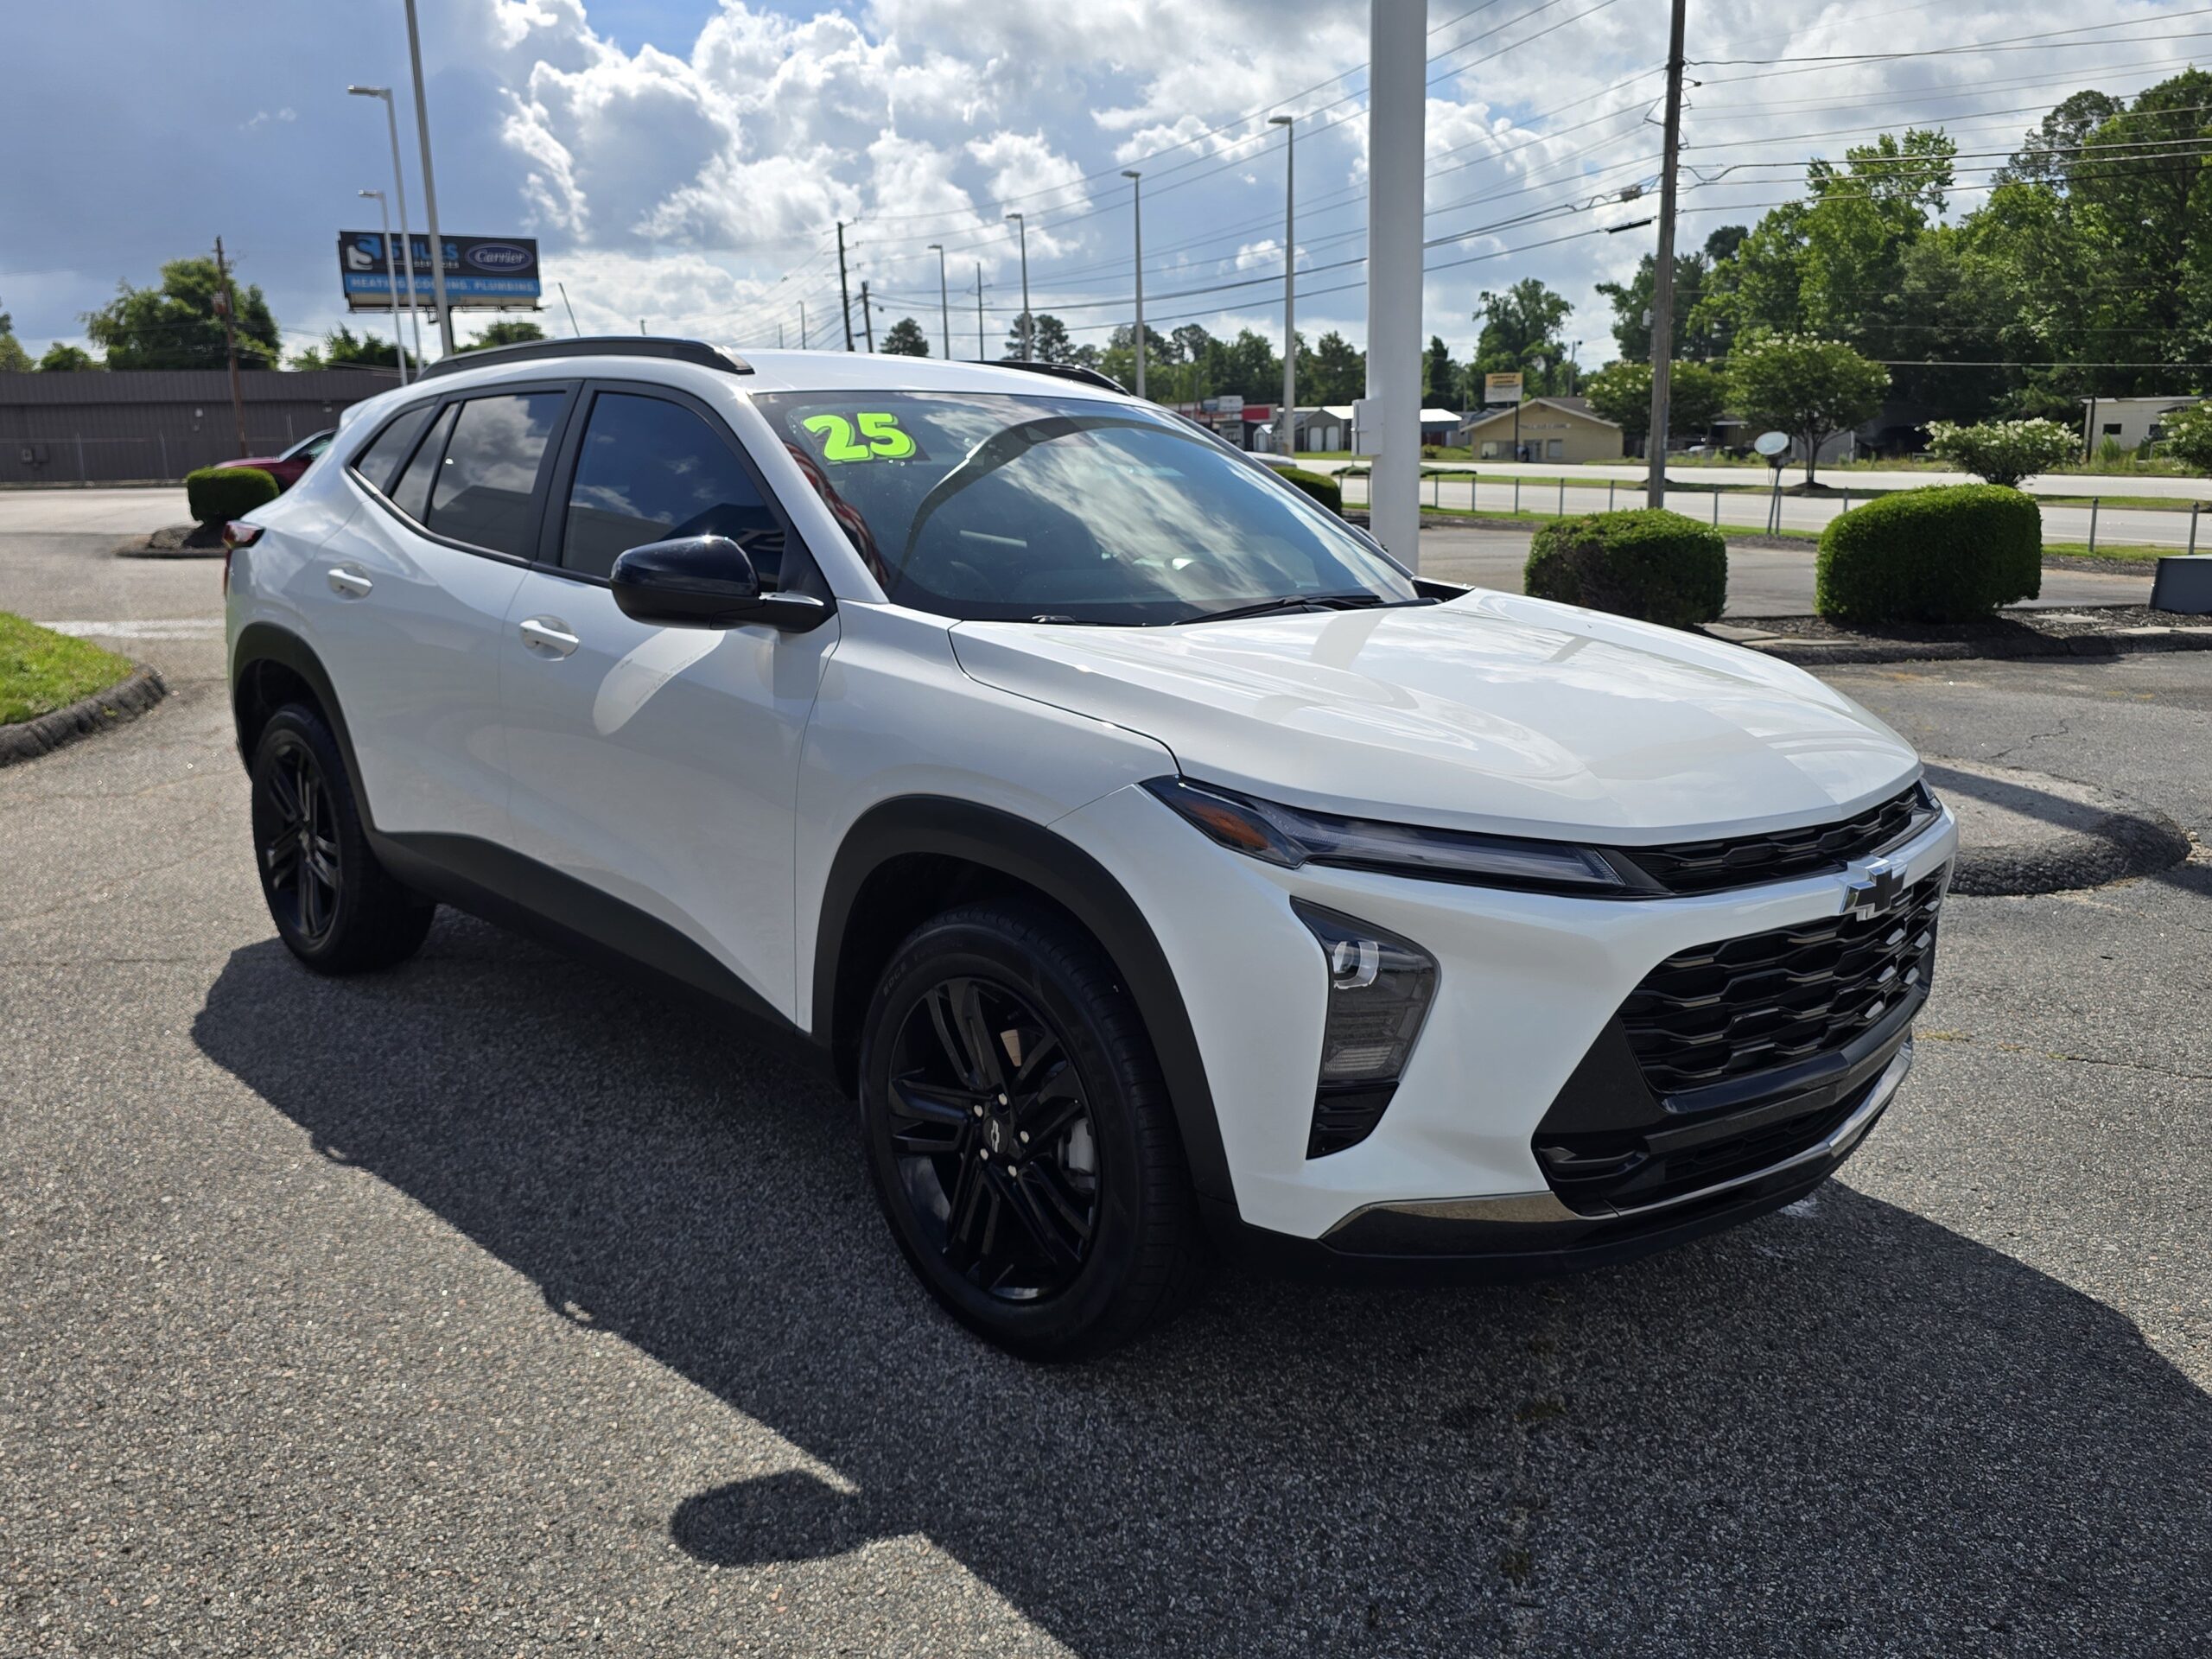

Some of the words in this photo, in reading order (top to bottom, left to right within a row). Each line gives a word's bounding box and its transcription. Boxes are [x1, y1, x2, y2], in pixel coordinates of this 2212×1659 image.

[387, 241, 459, 260] SILS
[474, 249, 524, 264] Carrier
[802, 412, 916, 461] 25
